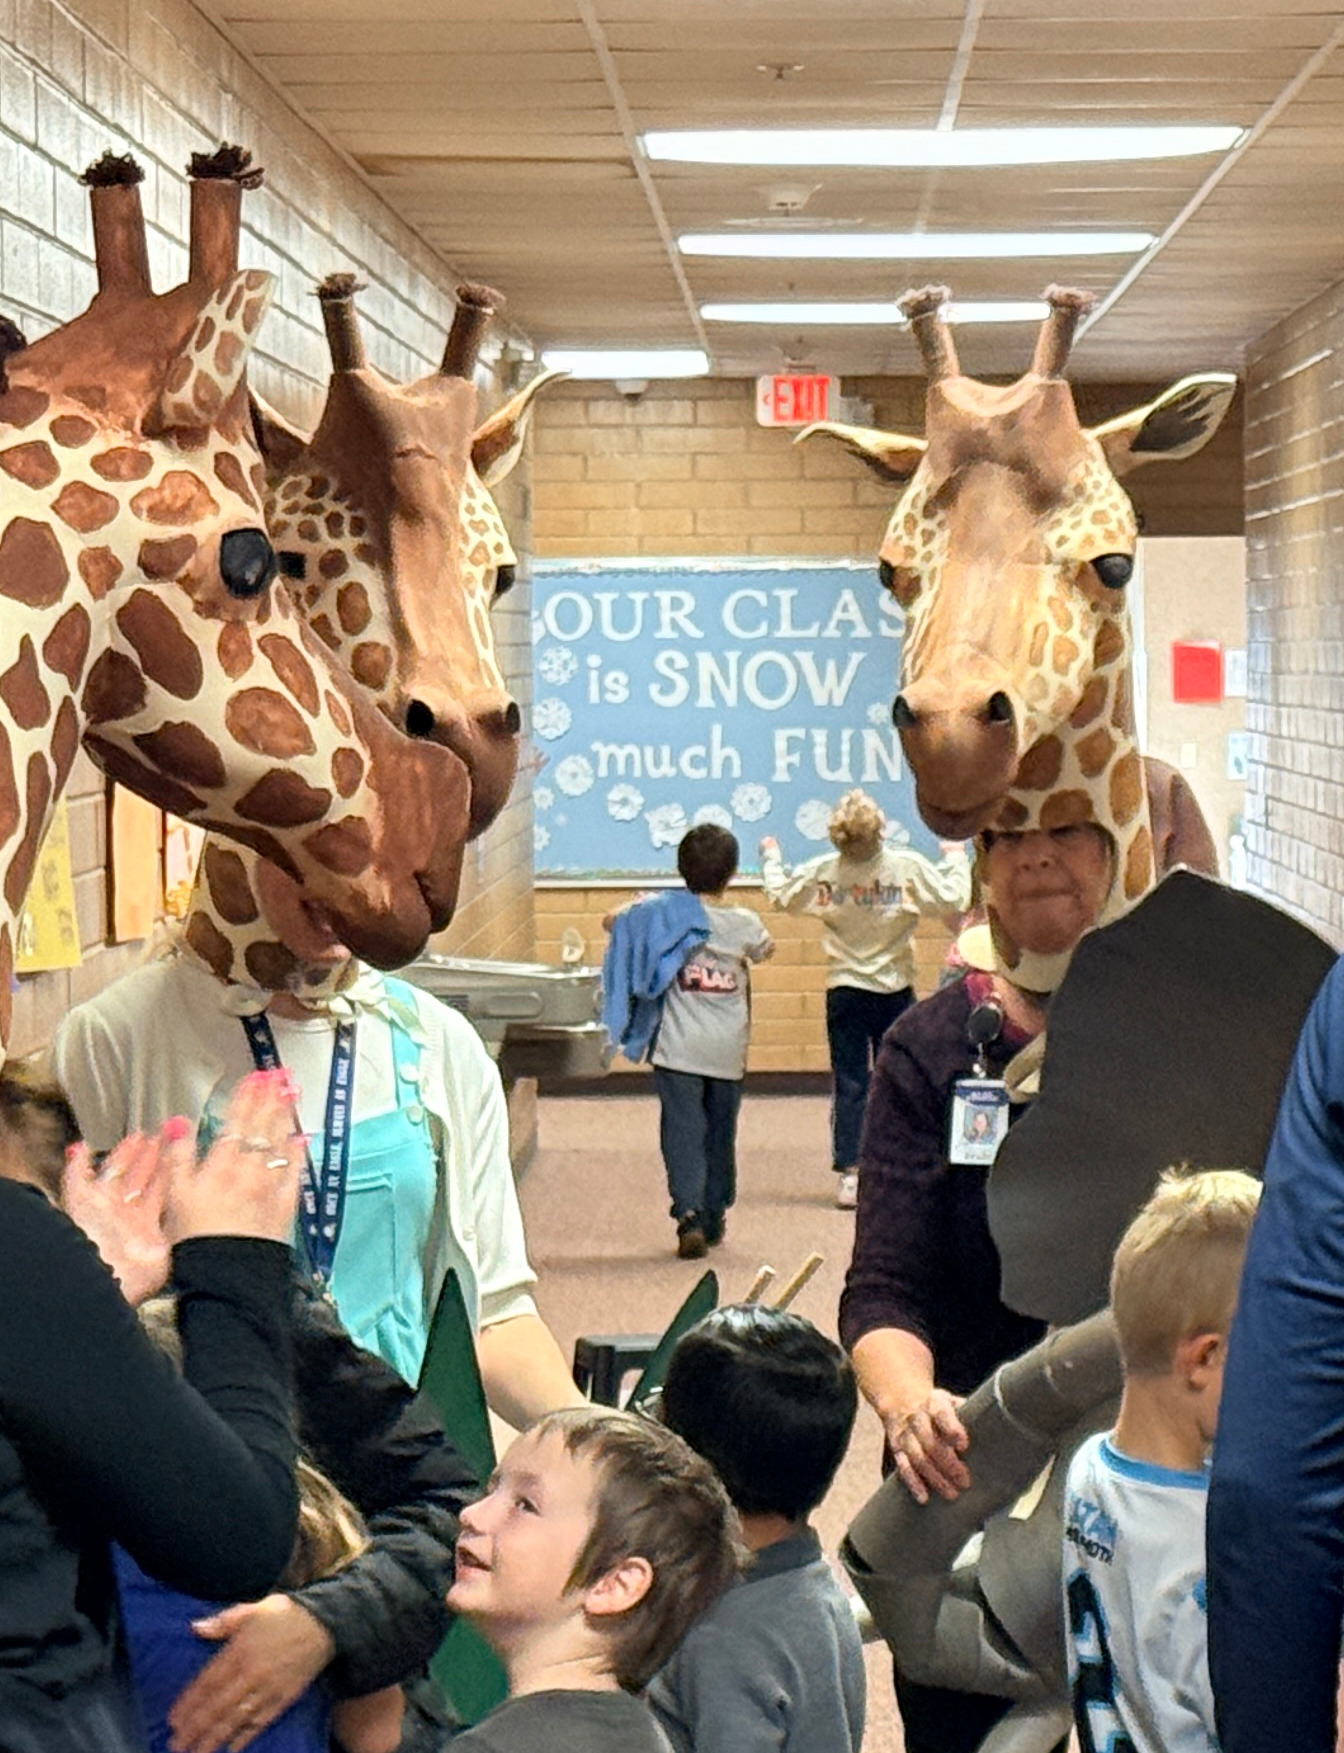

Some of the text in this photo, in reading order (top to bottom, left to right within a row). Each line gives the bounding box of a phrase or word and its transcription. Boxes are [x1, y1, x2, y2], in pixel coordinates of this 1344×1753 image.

[773, 376, 830, 422] EXIT
[543, 588, 704, 641] OUR
[587, 650, 867, 710] is SNOW
[591, 723, 902, 782] much FUN
